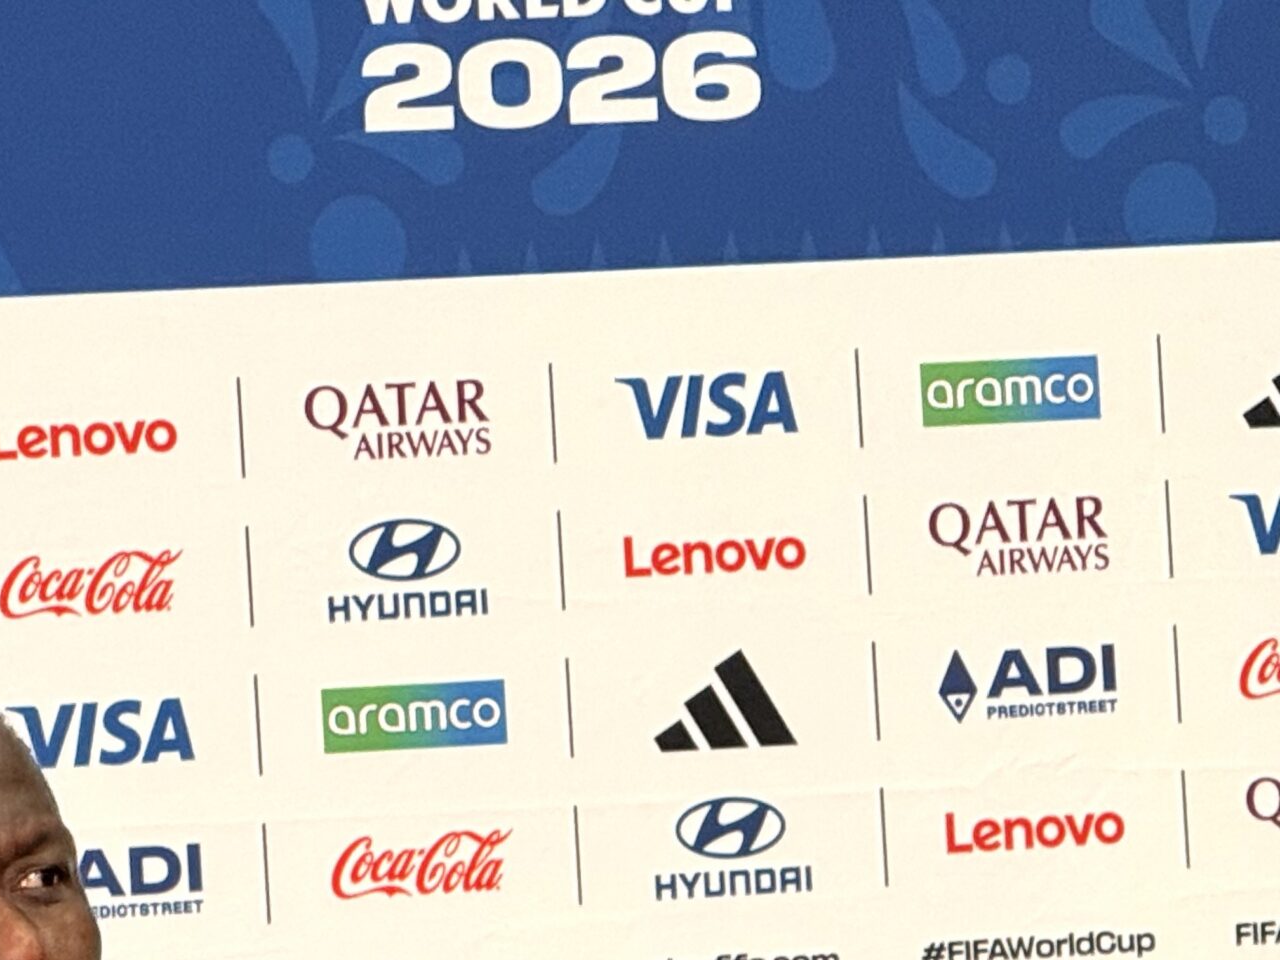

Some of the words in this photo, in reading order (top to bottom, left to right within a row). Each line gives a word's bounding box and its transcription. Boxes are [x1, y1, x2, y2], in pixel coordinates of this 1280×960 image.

[360, 31, 762, 133] 2026
[304, 378, 490, 440] QATAR
[615, 371, 798, 439] VISA
[926, 371, 1095, 410] aramco
[353, 427, 492, 461] AIRWAYS
[928, 496, 1108, 556] QATAR
[624, 537, 806, 577] Lenovo
[976, 544, 1110, 577] AIRWAYS
[0, 550, 181, 619] Coca-Cola
[328, 589, 488, 622] HYUNDAI
[987, 644, 1116, 698] ADI
[327, 697, 501, 737] aramco
[987, 699, 1118, 719] PREDICTSTREET
[7, 697, 196, 771] VISA
[945, 812, 1124, 853] Lenovo
[79, 843, 203, 897] ADI
[332, 830, 511, 899] Coca-Cola
[655, 866, 812, 900] HYUNDAI
